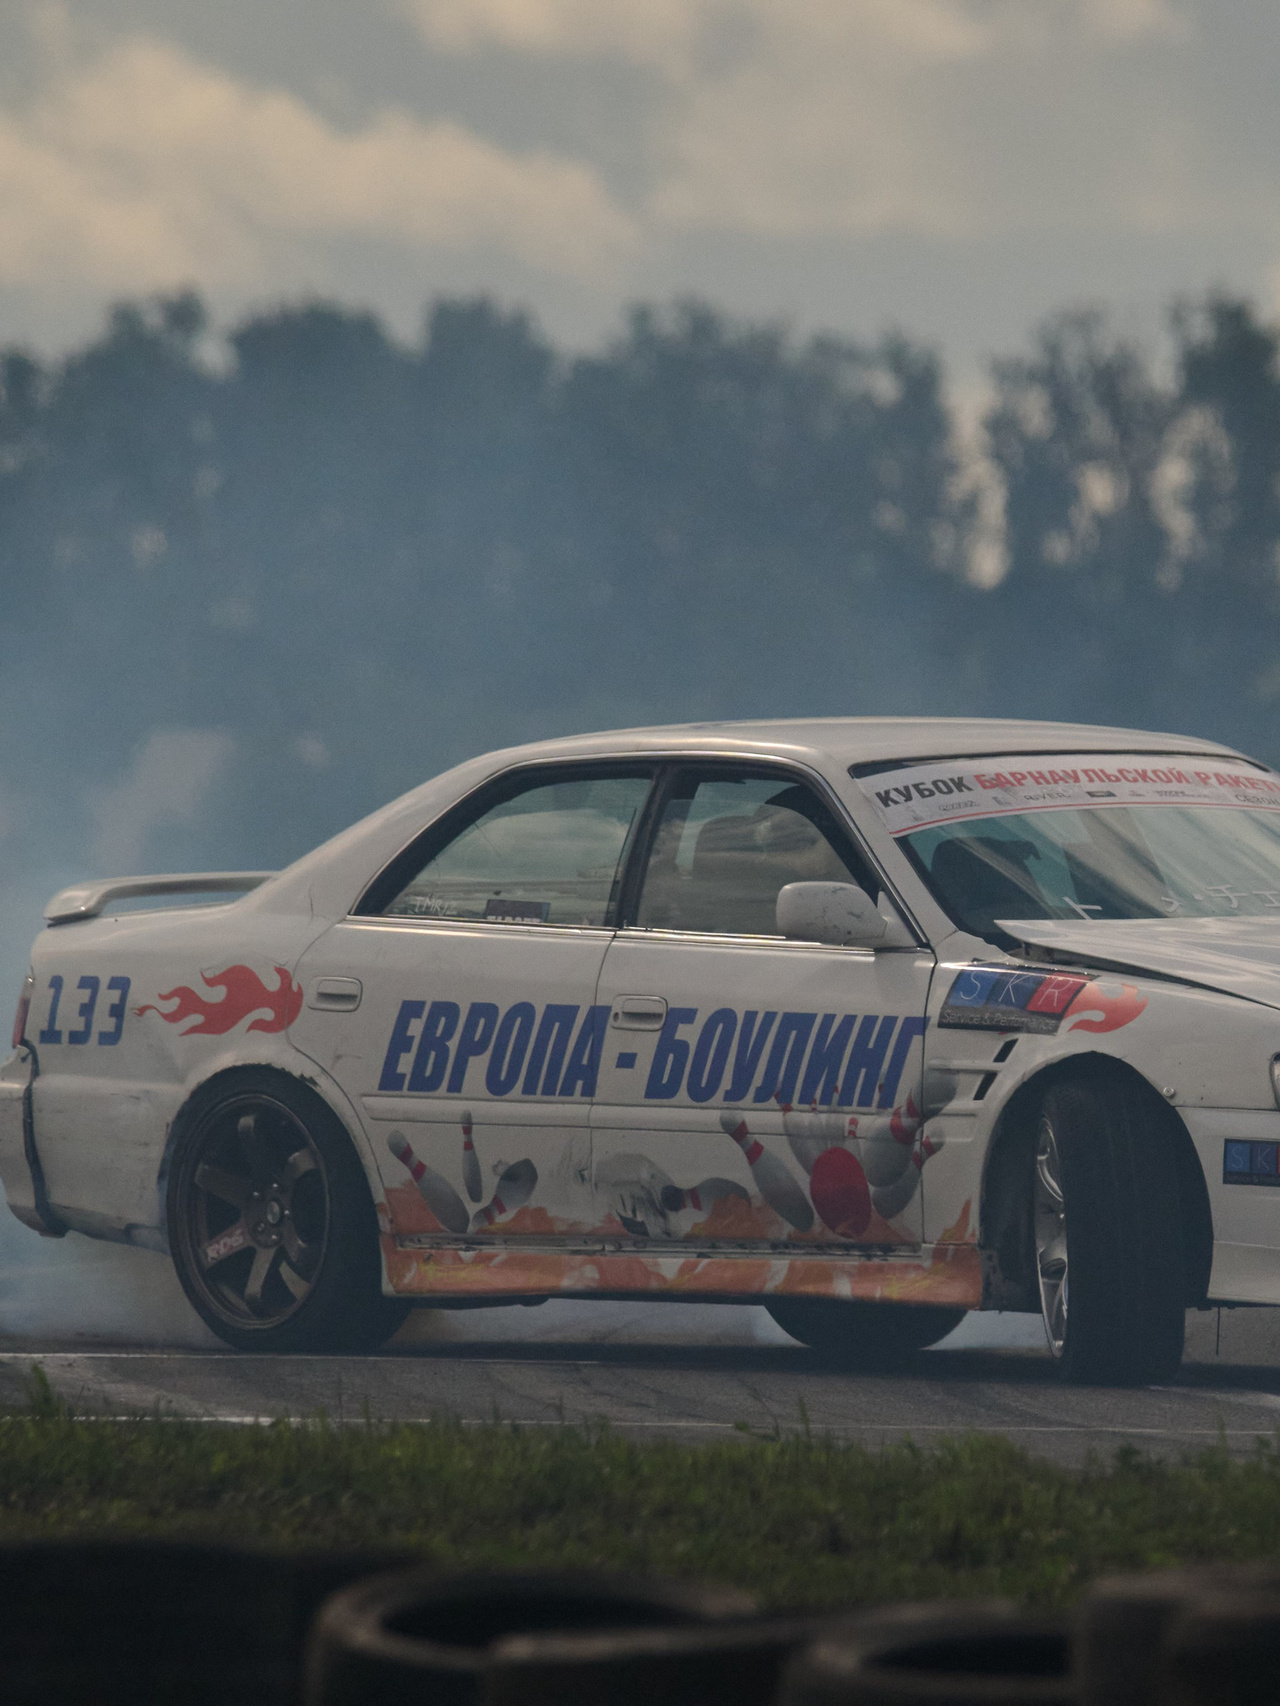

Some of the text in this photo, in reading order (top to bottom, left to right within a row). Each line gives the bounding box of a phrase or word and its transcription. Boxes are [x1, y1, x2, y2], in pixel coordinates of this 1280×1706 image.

[875, 776, 974, 808] КУБОК
[973, 766, 1190, 790] БАРНАУЛЬСКОЙ
[959, 970, 1075, 1007] SKR
[39, 975, 131, 1046] 133
[943, 1009, 981, 1024] Service
[378, 1000, 612, 1097] ЕВРОПА
[644, 1007, 931, 1109] БОУЛИНГ
